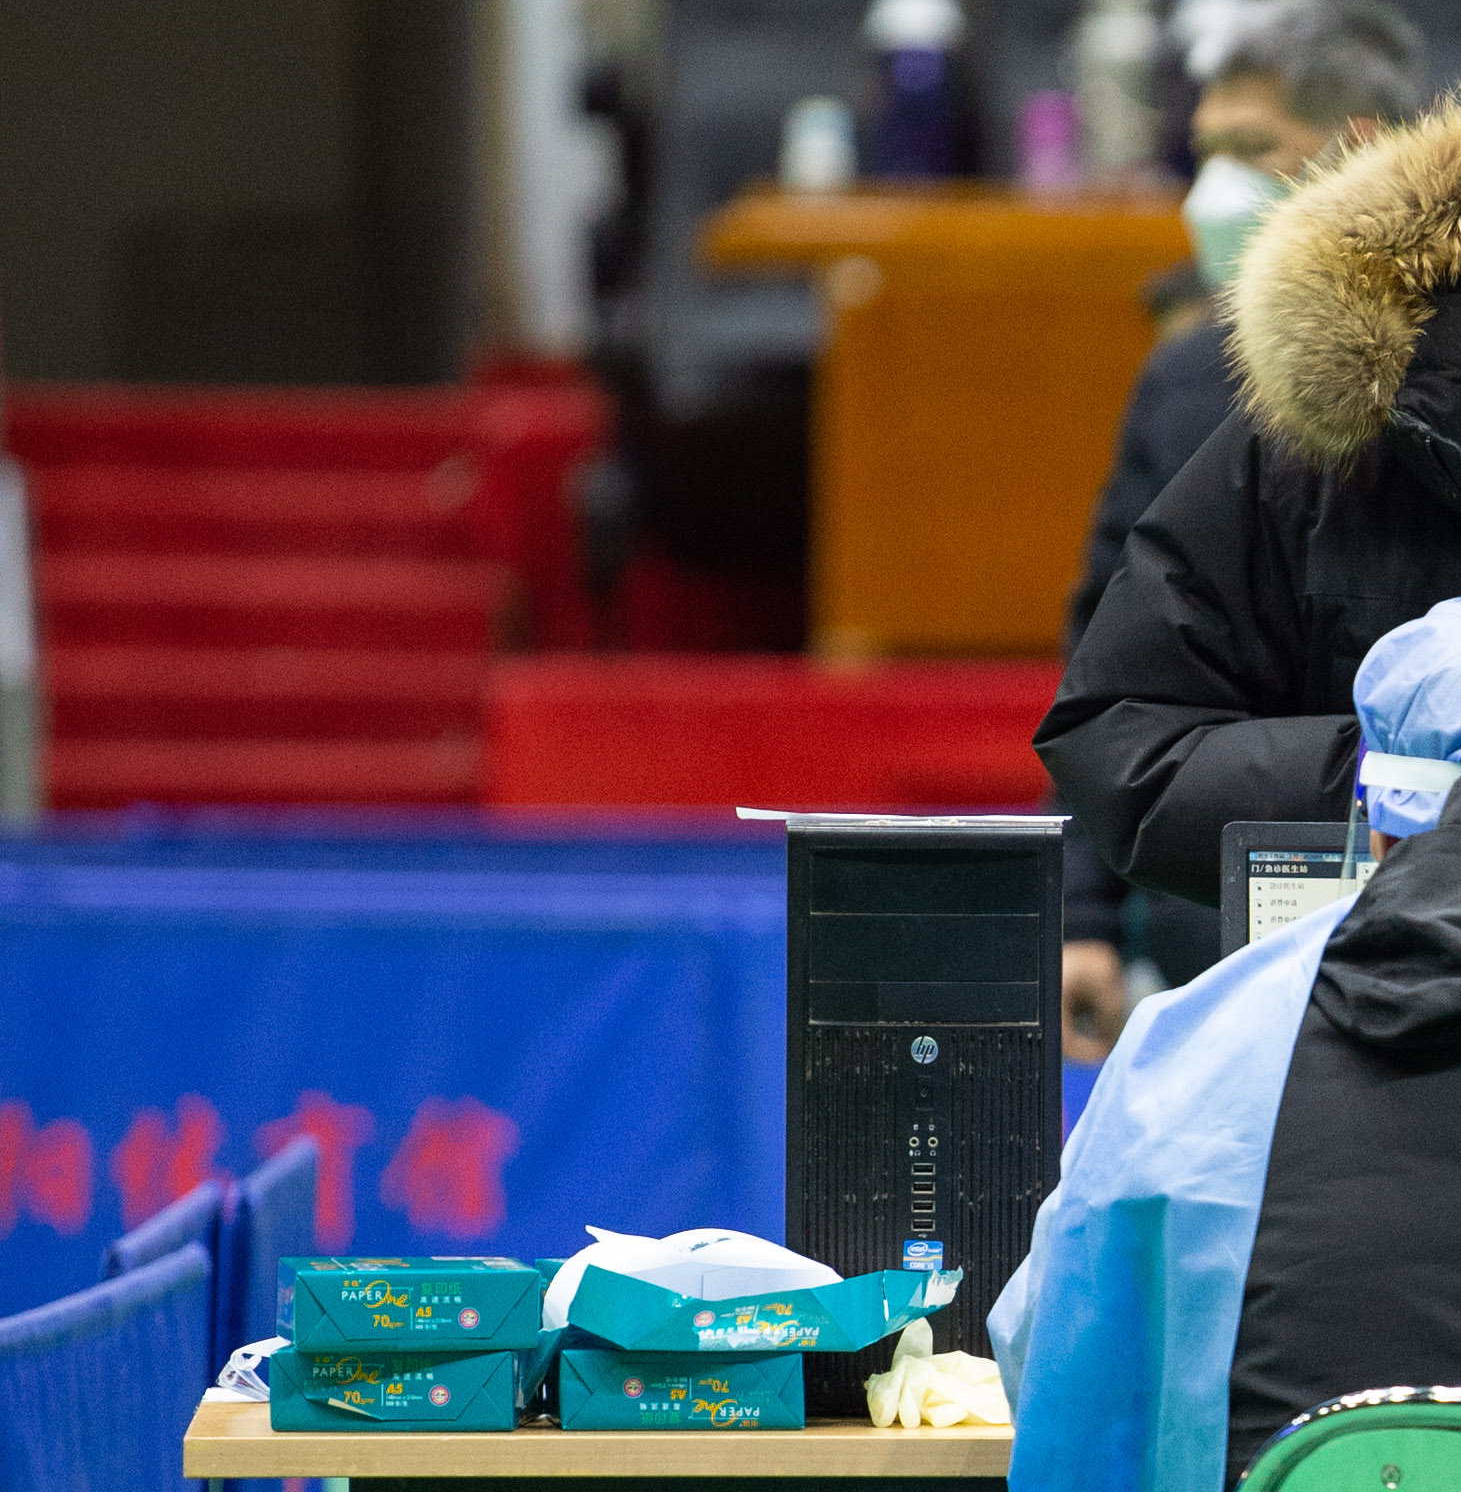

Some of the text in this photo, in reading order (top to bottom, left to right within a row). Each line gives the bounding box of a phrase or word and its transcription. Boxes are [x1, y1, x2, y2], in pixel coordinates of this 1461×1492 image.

[913, 1036, 937, 1064] hp
[341, 1290, 383, 1302] PAPER
[415, 1306, 433, 1317] A5
[781, 1326, 820, 1338] PAPER
[312, 1366, 353, 1377] PAPER
[385, 1382, 404, 1394] A5
[670, 1388, 687, 1399] A5
[718, 1406, 760, 1417] PAPER
